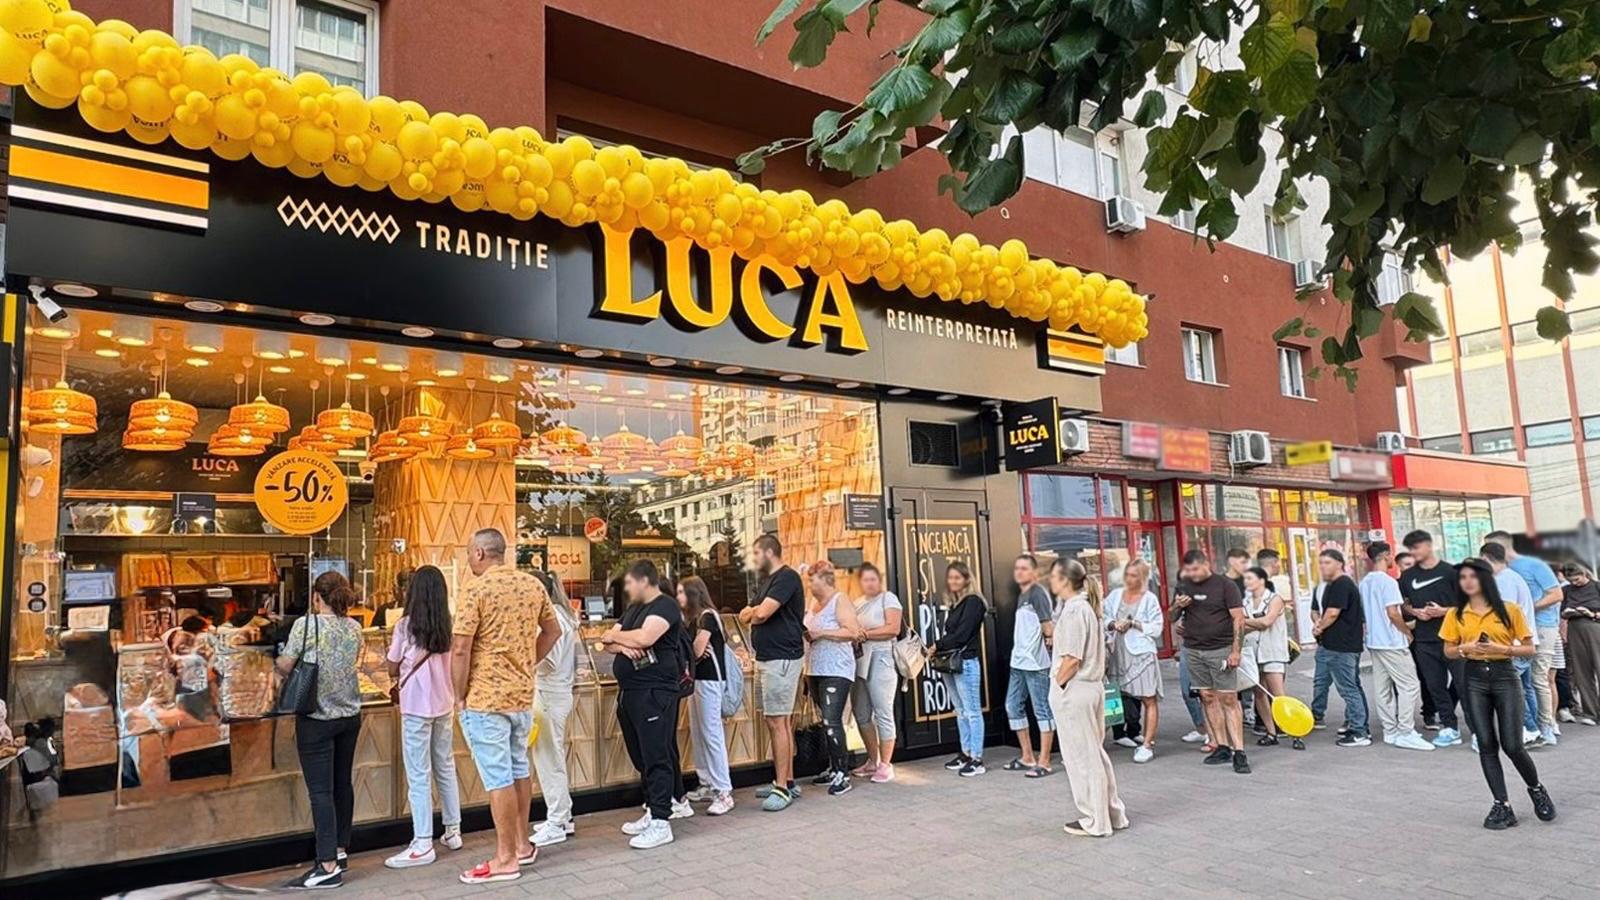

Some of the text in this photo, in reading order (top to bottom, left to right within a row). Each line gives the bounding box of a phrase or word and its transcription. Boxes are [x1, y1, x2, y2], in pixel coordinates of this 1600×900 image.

[416, 220, 549, 270] TRADIȚIE
[599, 219, 869, 351] LUCA
[886, 308, 1018, 350] REINTERPRETATĂ
[1009, 424, 1050, 445] LUCA
[192, 458, 240, 471] LUCA
[264, 469, 334, 503] -50%
[910, 525, 972, 556] ÎNCEARCĂ
